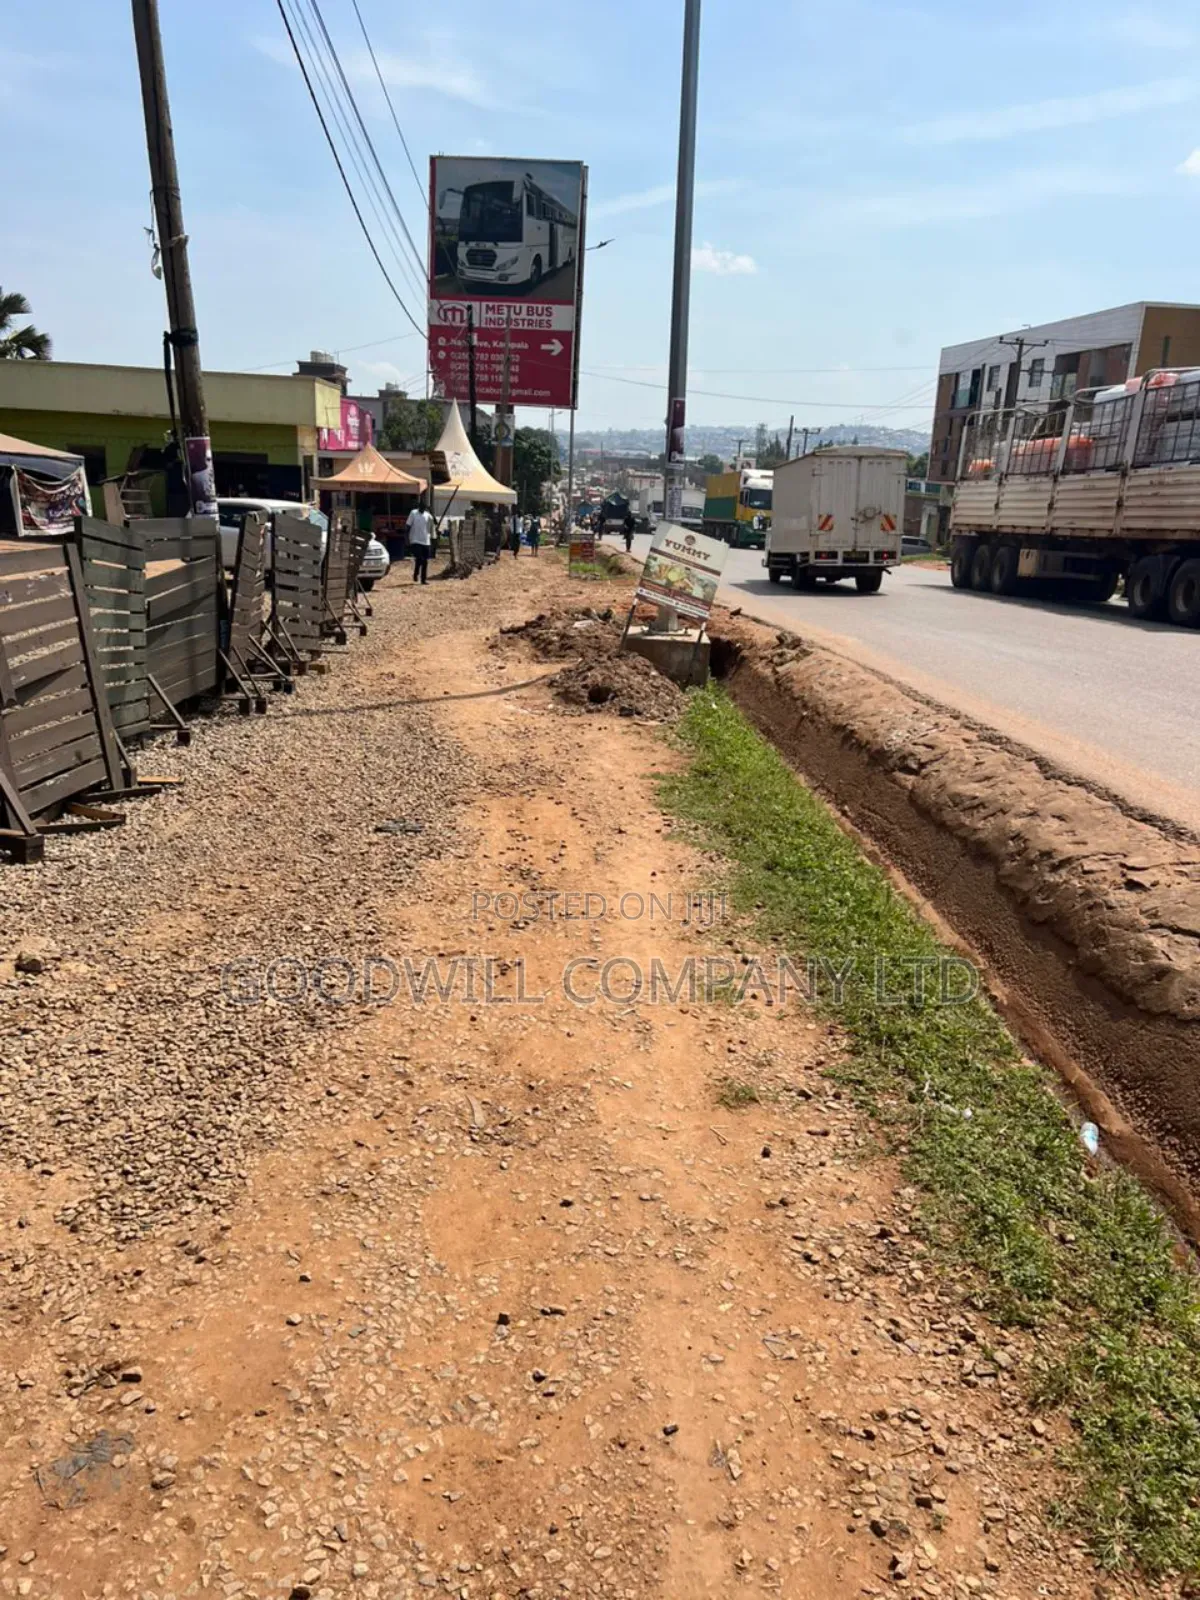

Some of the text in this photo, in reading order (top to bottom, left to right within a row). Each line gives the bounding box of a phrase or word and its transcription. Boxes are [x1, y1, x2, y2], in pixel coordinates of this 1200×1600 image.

[485, 303, 553, 317] METU BUS
[484, 317, 552, 329] INDUSTRIES
[664, 539, 711, 561] YUMMY
